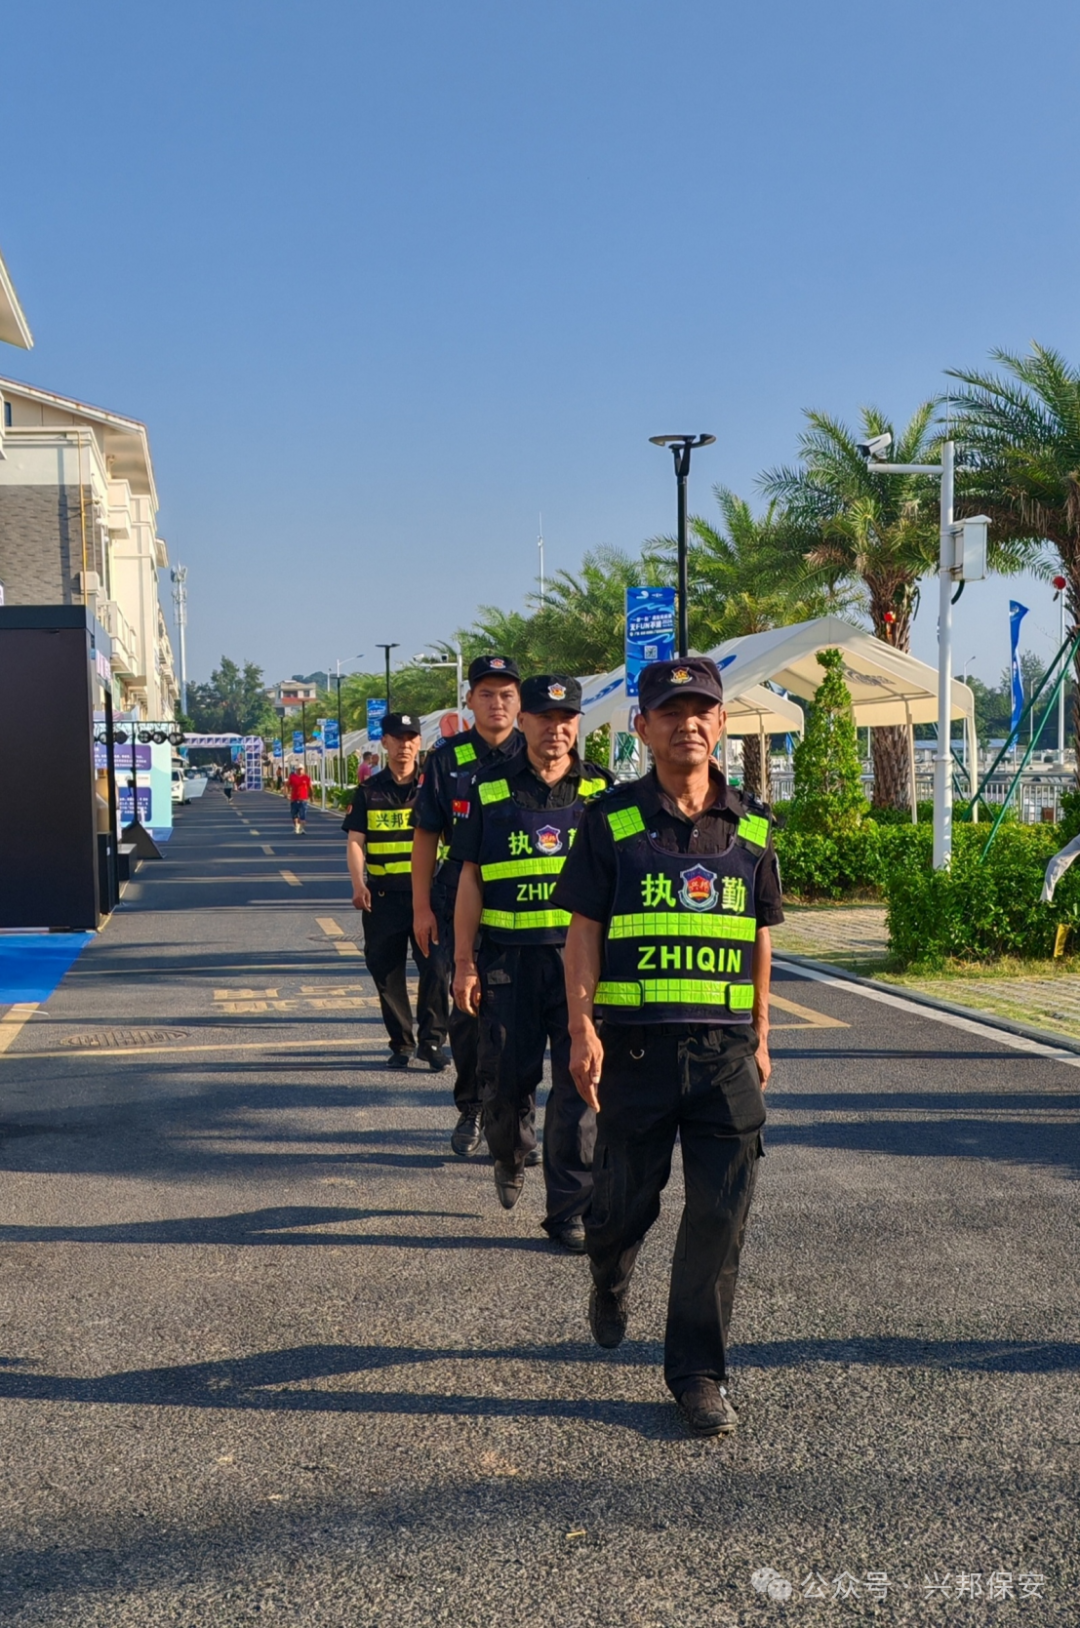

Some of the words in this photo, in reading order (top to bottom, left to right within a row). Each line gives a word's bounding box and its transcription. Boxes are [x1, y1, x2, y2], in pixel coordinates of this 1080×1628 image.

[508, 831, 533, 855] 执
[641, 873, 676, 907] 执
[722, 876, 746, 912] 勤
[637, 945, 742, 973] ZHIQIN
